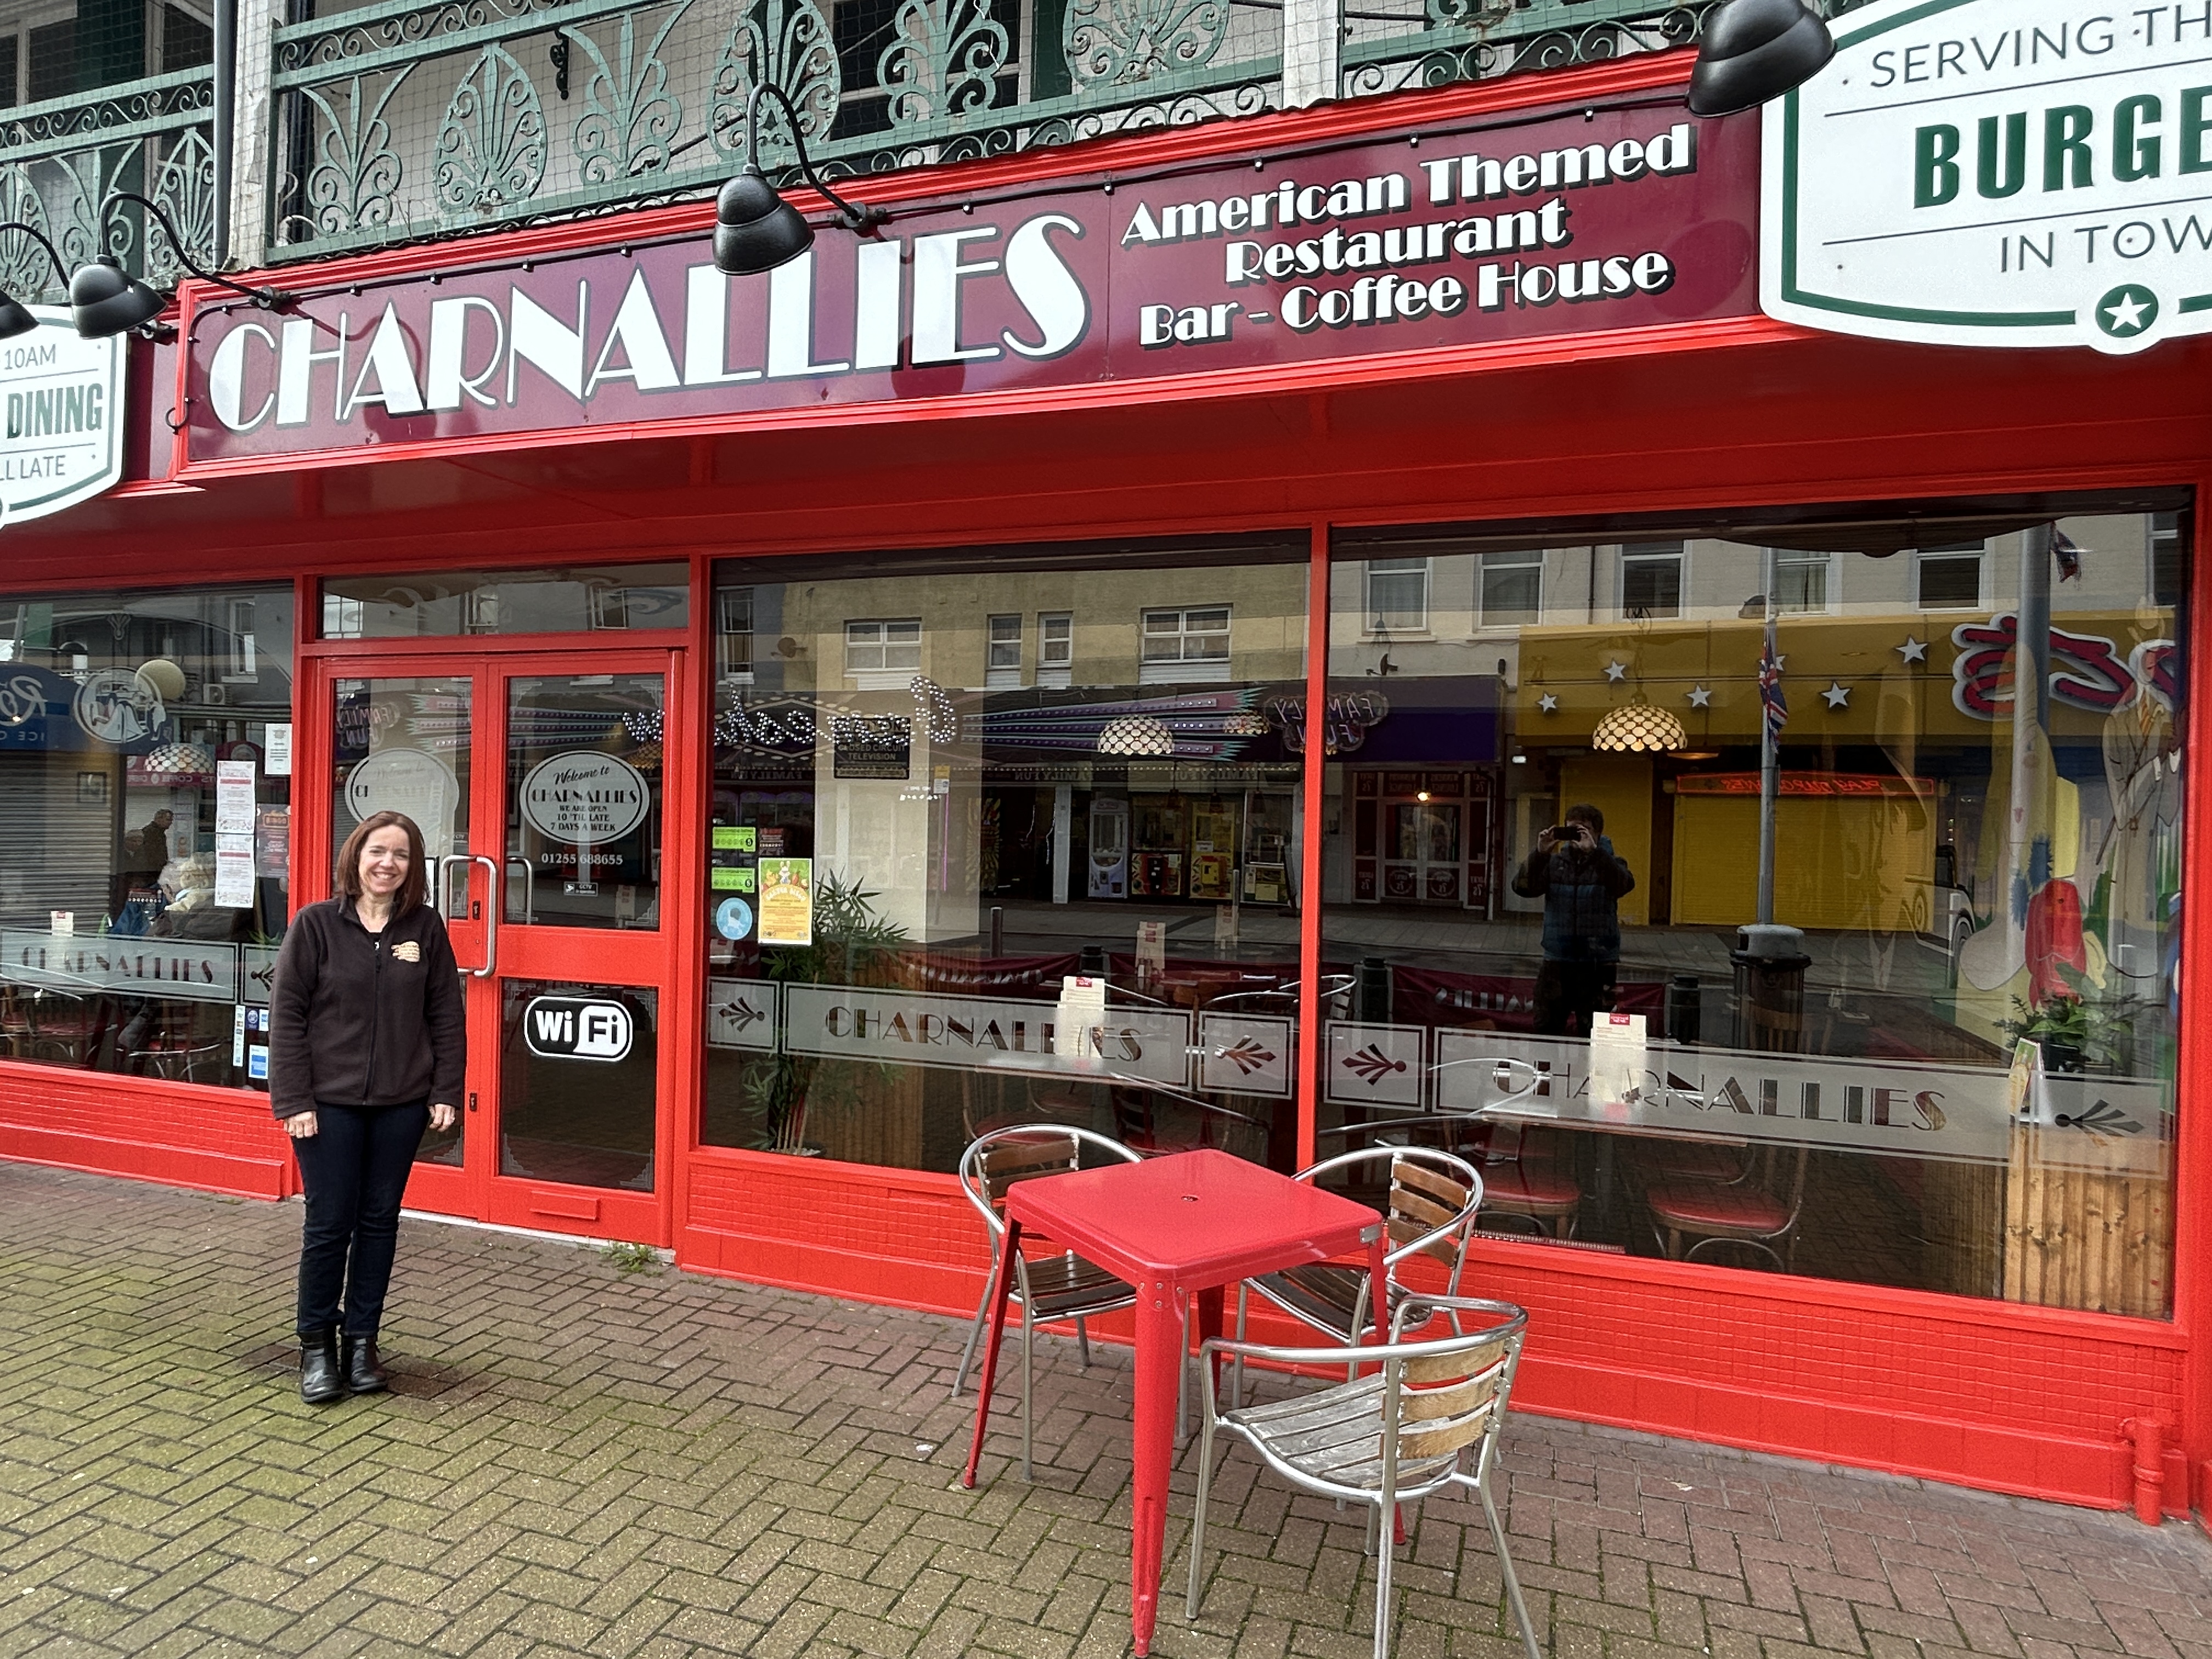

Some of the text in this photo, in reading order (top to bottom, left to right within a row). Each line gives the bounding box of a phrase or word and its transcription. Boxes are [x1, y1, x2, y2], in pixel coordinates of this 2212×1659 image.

[1870, 16, 2114, 87] SERVING
[1914, 86, 2212, 210] BURGE
[1121, 123, 1690, 246] American Themed
[1225, 197, 1567, 283] Restaurant
[2001, 216, 2212, 273] IN TOW
[208, 215, 1086, 432] CHARNALLIES
[1140, 301, 1238, 346] Bar
[1282, 274, 1463, 329] Coffee
[1479, 251, 1668, 307] House
[4, 343, 56, 370] 10AM
[7, 383, 103, 439] DINING
[20, 455, 66, 479] LATE
[872, 743, 905, 752] CIRCUIT
[532, 789, 637, 804] CHARNALLIES
[554, 768, 599, 785] Welcome
[550, 822, 555, 831] 7
[558, 822, 579, 831] DAYS
[590, 823, 616, 832] WEEK
[557, 813, 567, 821] 10
[541, 853, 623, 865] 01255 688655
[825, 1005, 1142, 1062] CHARNALLES
